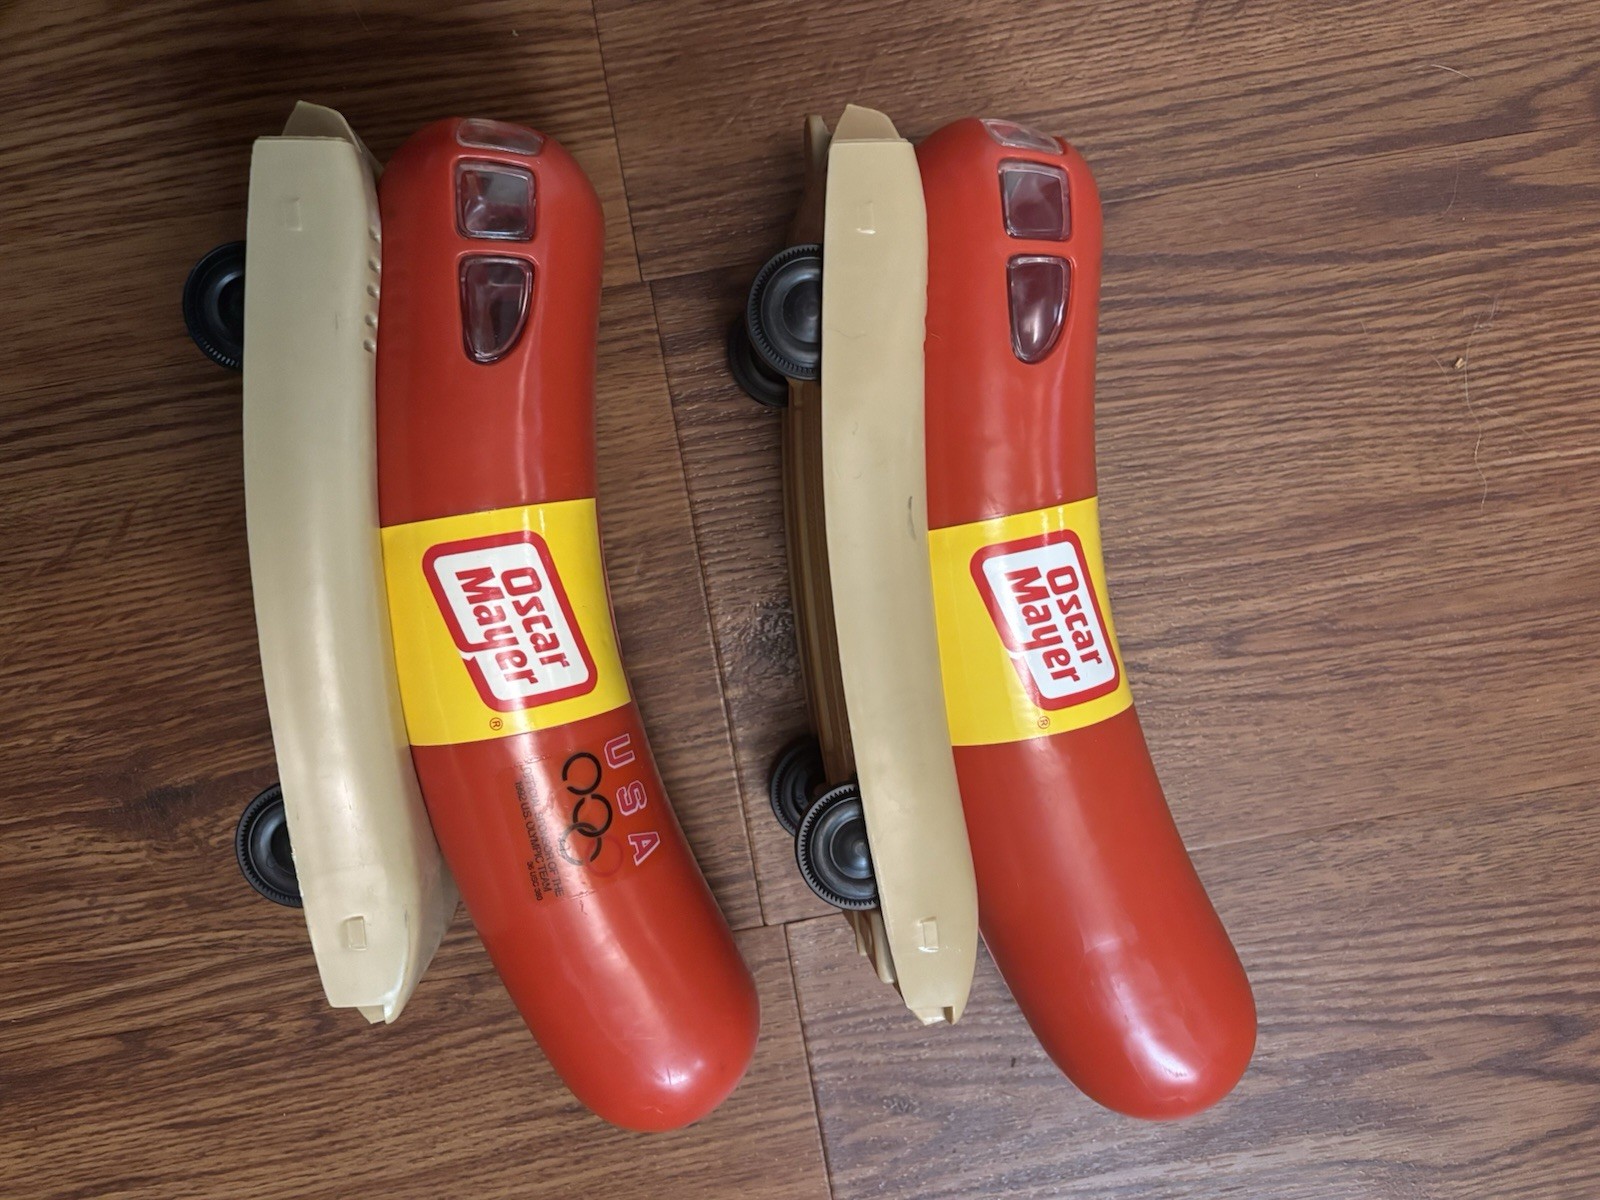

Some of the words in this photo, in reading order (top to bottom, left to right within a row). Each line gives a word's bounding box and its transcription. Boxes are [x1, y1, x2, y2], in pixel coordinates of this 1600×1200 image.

[455, 566, 539, 685] Mayer
[501, 567, 570, 668] Oscar
[1005, 566, 1080, 682] Mayer
[1046, 565, 1102, 664] Oscar
[526, 821, 544, 863] OLYMPIC
[538, 864, 552, 892] TEAM
[548, 861, 559, 875] OF
[552, 878, 564, 897] THE
